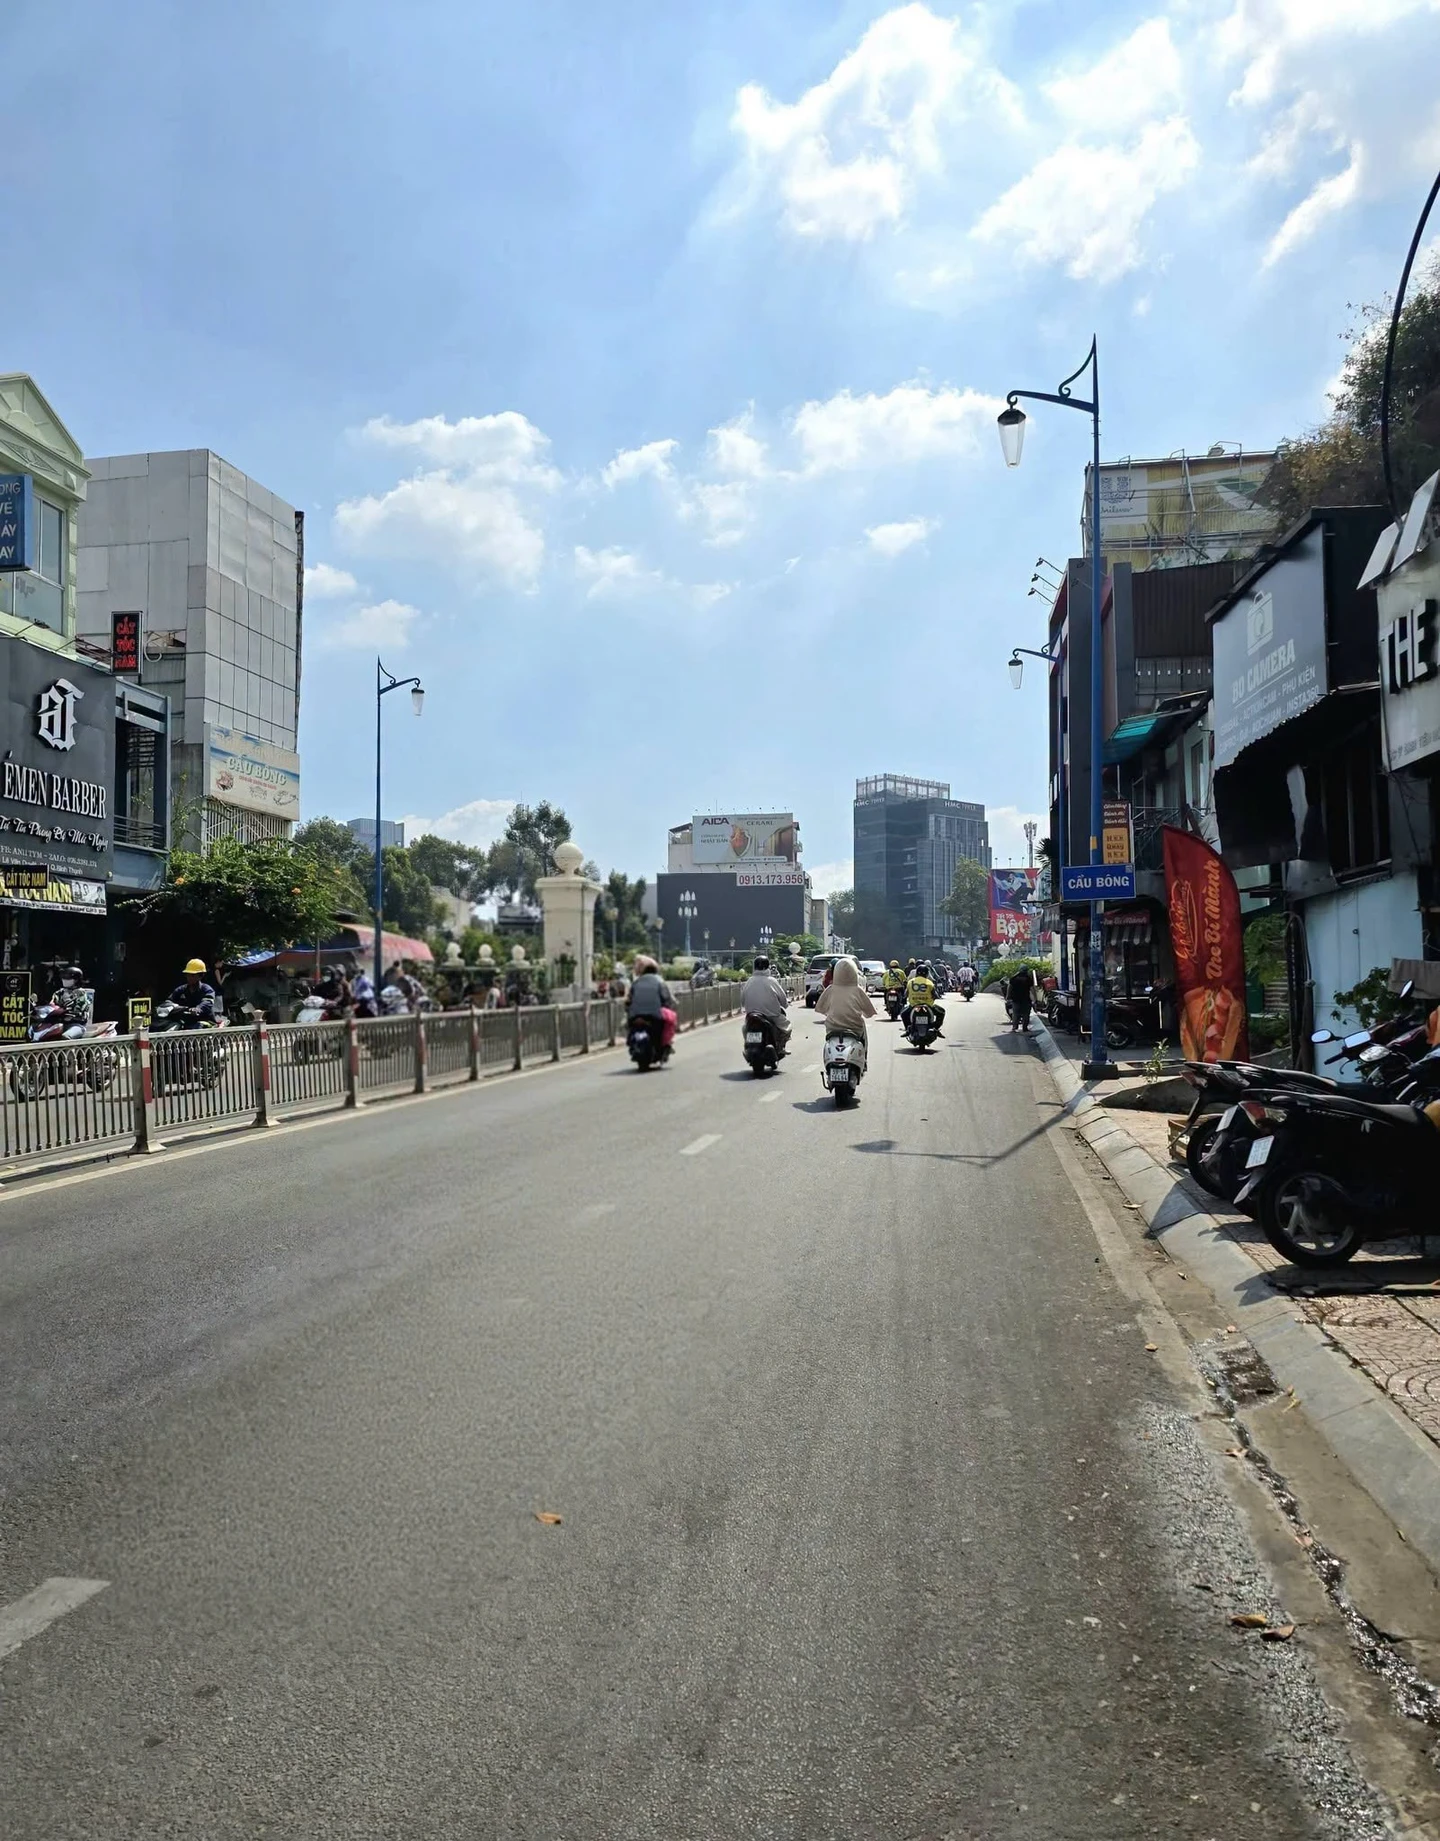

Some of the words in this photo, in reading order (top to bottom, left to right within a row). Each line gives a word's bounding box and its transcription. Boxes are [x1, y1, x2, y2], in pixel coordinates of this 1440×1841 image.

[1380, 600, 1428, 685] THE
[1247, 638, 1296, 692] CAMERA
[3, 750, 48, 806] ÉMEN
[51, 773, 107, 820] BARBER
[6, 867, 18, 886] CẮT
[18, 870, 31, 886] TÓC
[31, 872, 46, 887] NAM
[739, 874, 804, 885] 0913.173.956
[1067, 873, 1092, 889] CẦU
[1096, 873, 1130, 888] BÔNG
[911, 981, 927, 992] be
[2, 992, 25, 1009] CẮT
[2, 1009, 24, 1024] TÓC
[0, 1026, 27, 1038] NAM
